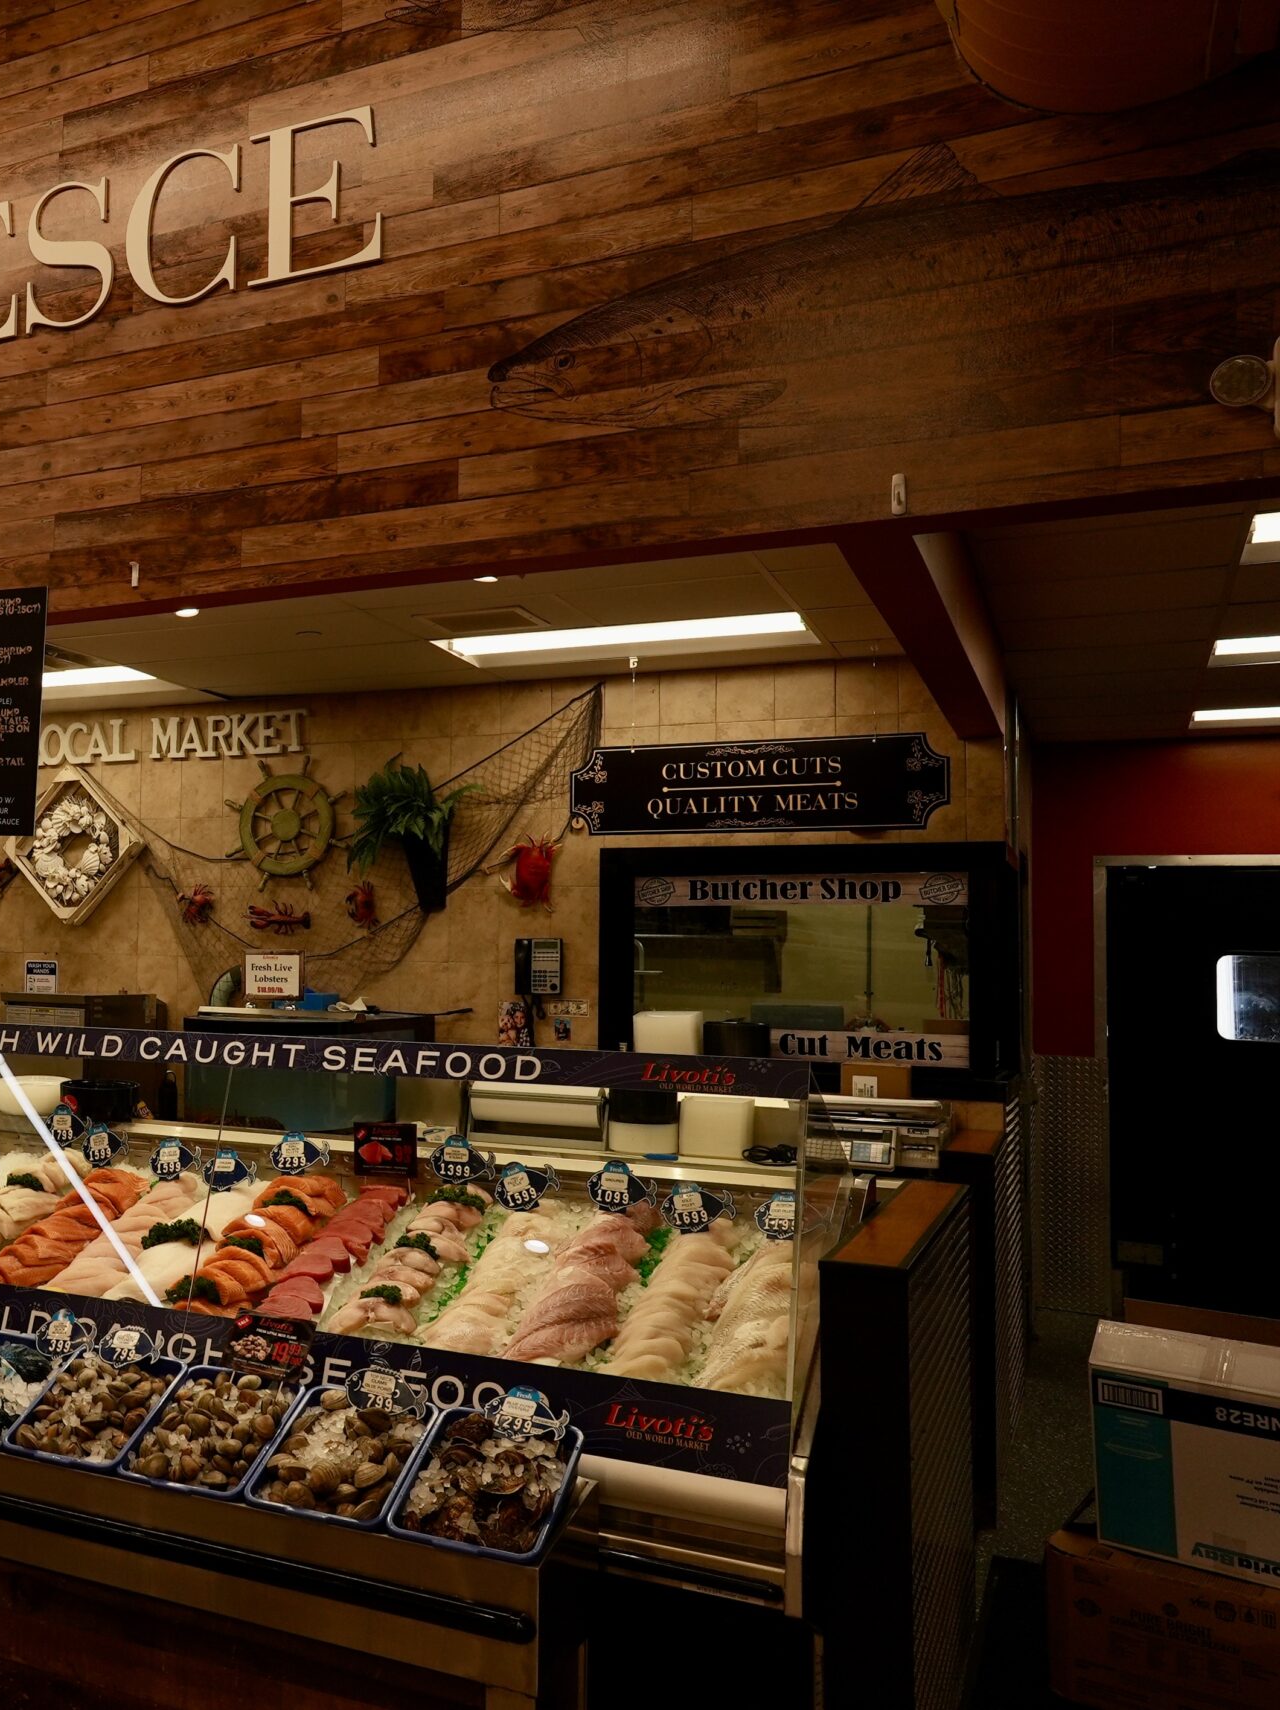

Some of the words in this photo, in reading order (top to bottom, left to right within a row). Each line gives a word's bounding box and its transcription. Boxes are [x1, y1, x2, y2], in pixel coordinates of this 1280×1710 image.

[16, 724, 30, 733] ON
[38, 719, 135, 766] OCAL
[149, 709, 308, 759] MARKET
[5, 757, 25, 766] TAIL
[662, 760, 765, 780] CUSTOM
[773, 757, 842, 776] CUTS
[647, 795, 764, 819] QUALITY
[775, 792, 858, 812] MEATS
[688, 878, 813, 901] Butcher
[820, 878, 901, 903] Shop
[251, 963, 272, 971] Fresh
[274, 963, 293, 972] Live
[254, 974, 288, 983] Lobsters
[37, 1031, 123, 1058] WILD
[140, 1036, 306, 1068] CAUGHT
[322, 1045, 542, 1081] SEAFOOD
[780, 1033, 830, 1057] Cut
[847, 1035, 943, 1062] Meats
[640, 1061, 737, 1086] Livoti's
[659, 1082, 674, 1090] OLD
[676, 1084, 701, 1092] WORLD
[703, 1086, 733, 1094] MARKET
[89, 1149, 111, 1160] 1599
[278, 1156, 306, 1168] 2299
[157, 1161, 181, 1174] 1599
[440, 1163, 470, 1177] 1399
[506, 1187, 537, 1207] 1599
[596, 1190, 630, 1204] 1099
[674, 1209, 708, 1226] 1699
[48, 1340, 71, 1352] 399
[113, 1348, 135, 1360] 799
[367, 1394, 394, 1412] 799
[494, 1412, 533, 1433] 1299
[604, 1402, 715, 1441] Livoti's
[626, 1430, 642, 1441] OLD
[645, 1432, 674, 1446] WORLD
[676, 1438, 710, 1451] MARKET
